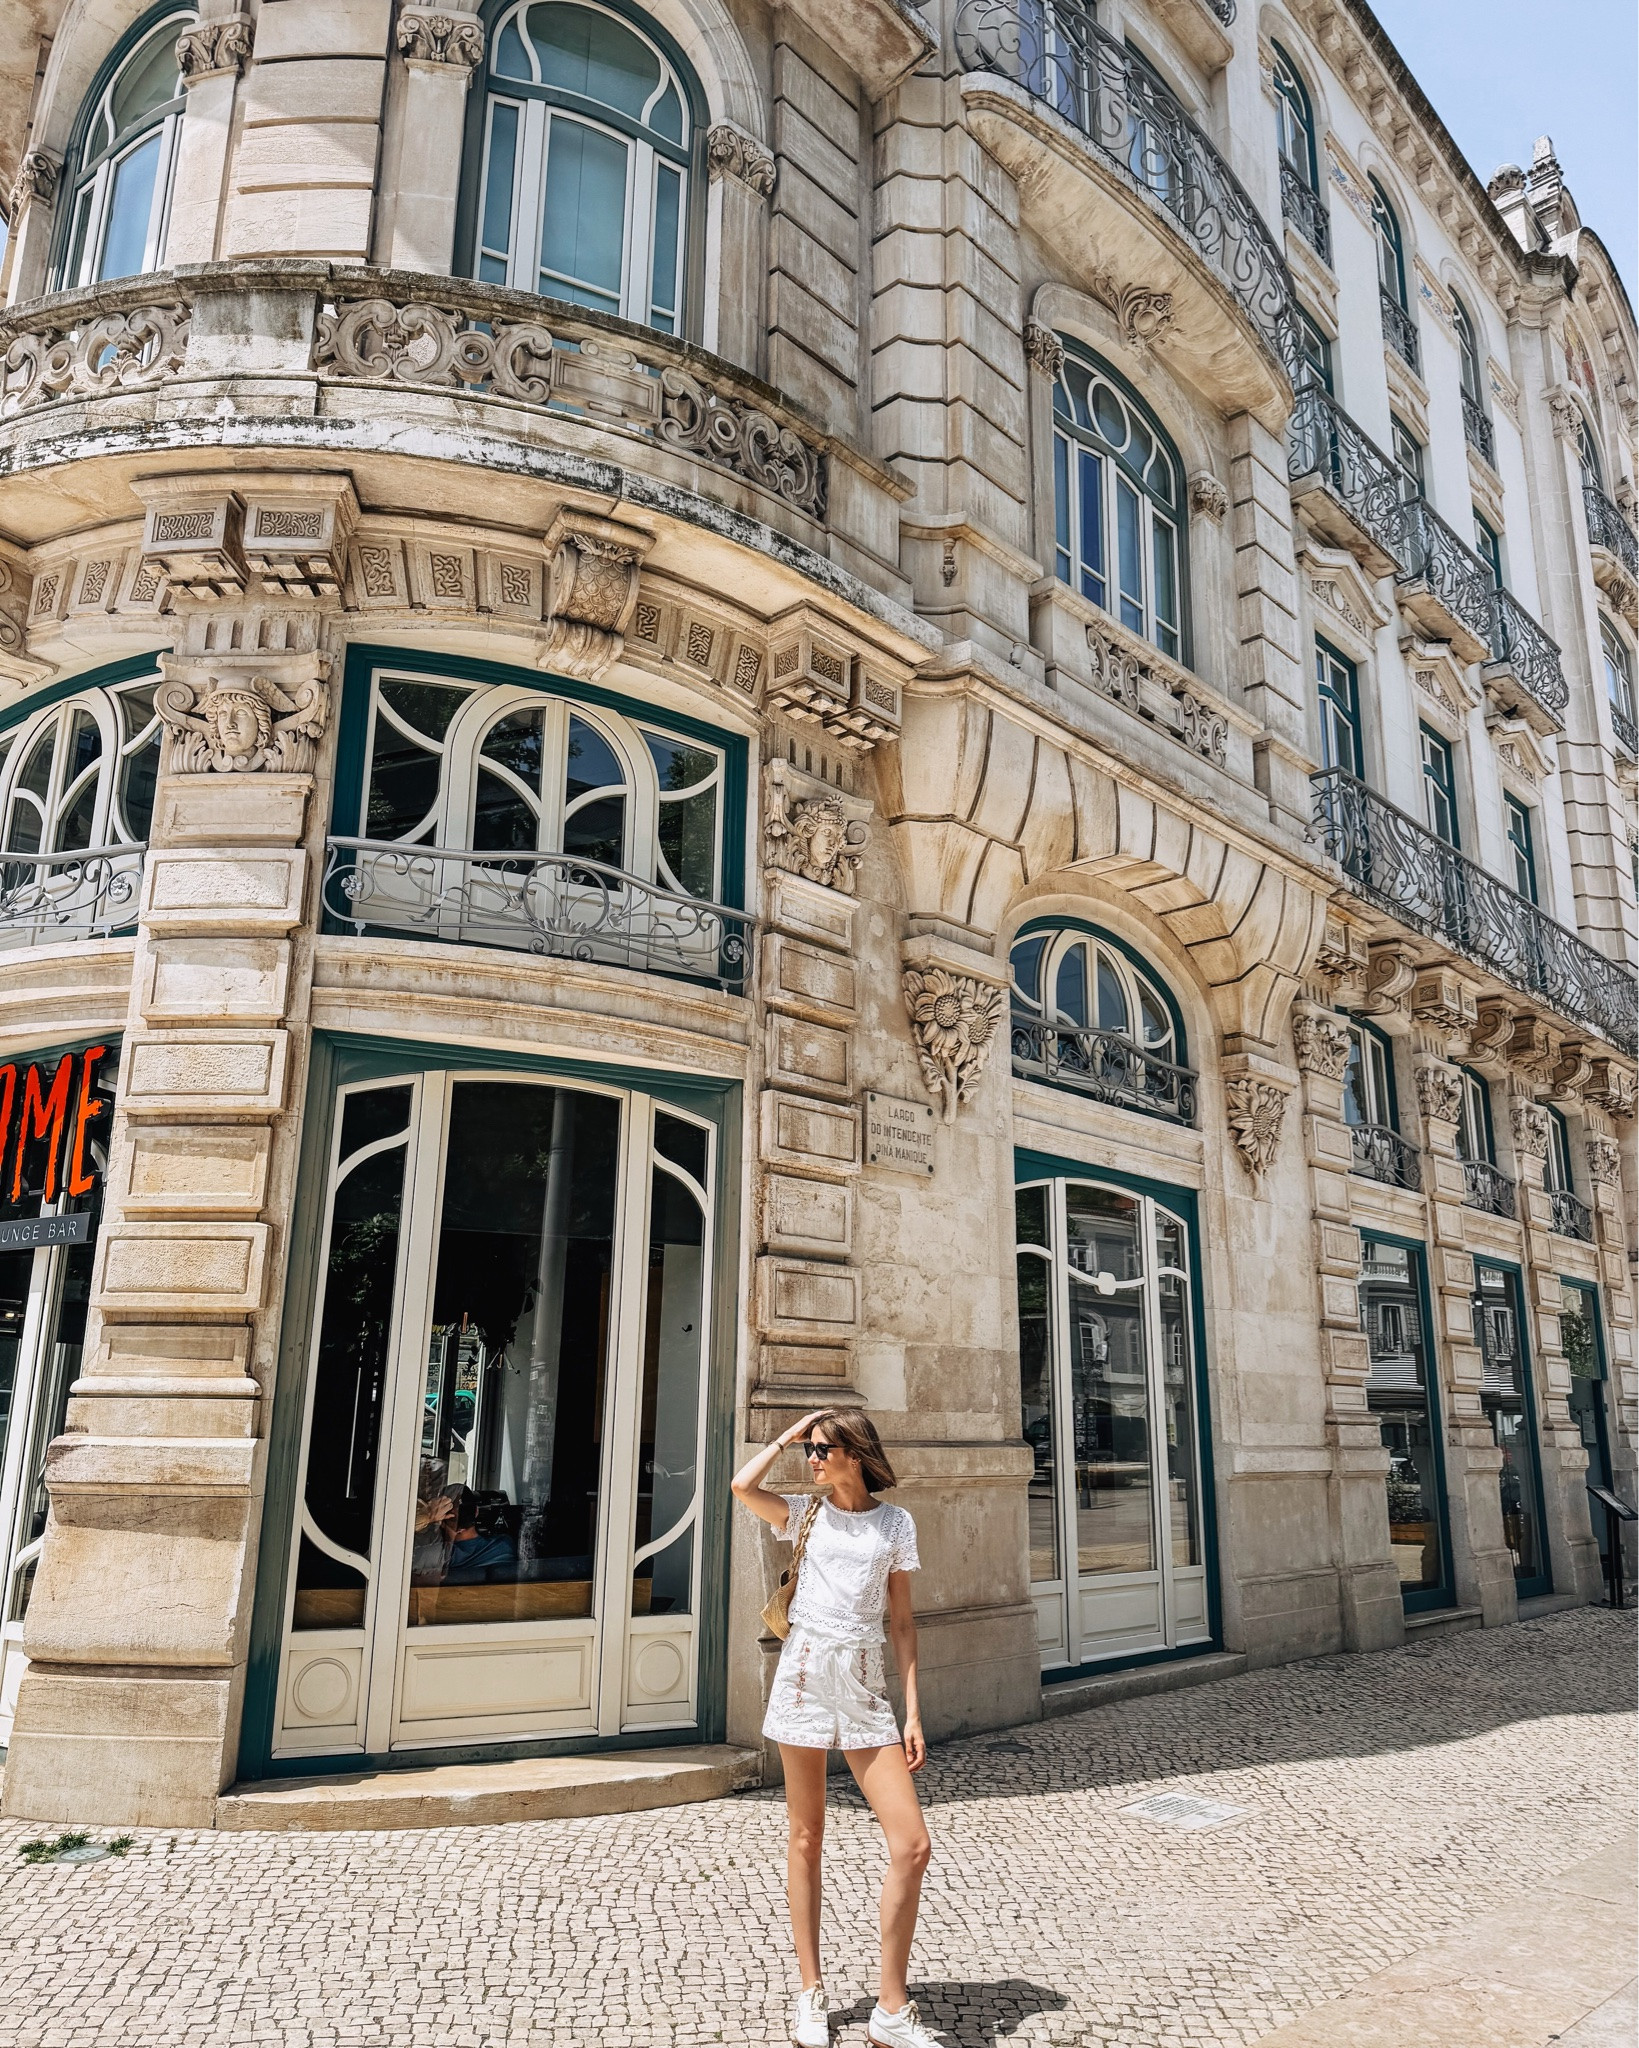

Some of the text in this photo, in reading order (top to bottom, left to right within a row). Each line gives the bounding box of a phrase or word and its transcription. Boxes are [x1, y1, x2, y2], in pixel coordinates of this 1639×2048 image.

[888, 1106, 915, 1123] LARGO
[871, 1122, 932, 1146] DO INTENDENTE
[876, 1143, 927, 1164] PINA MANIQUE
[47, 1221, 77, 1239] BAR
